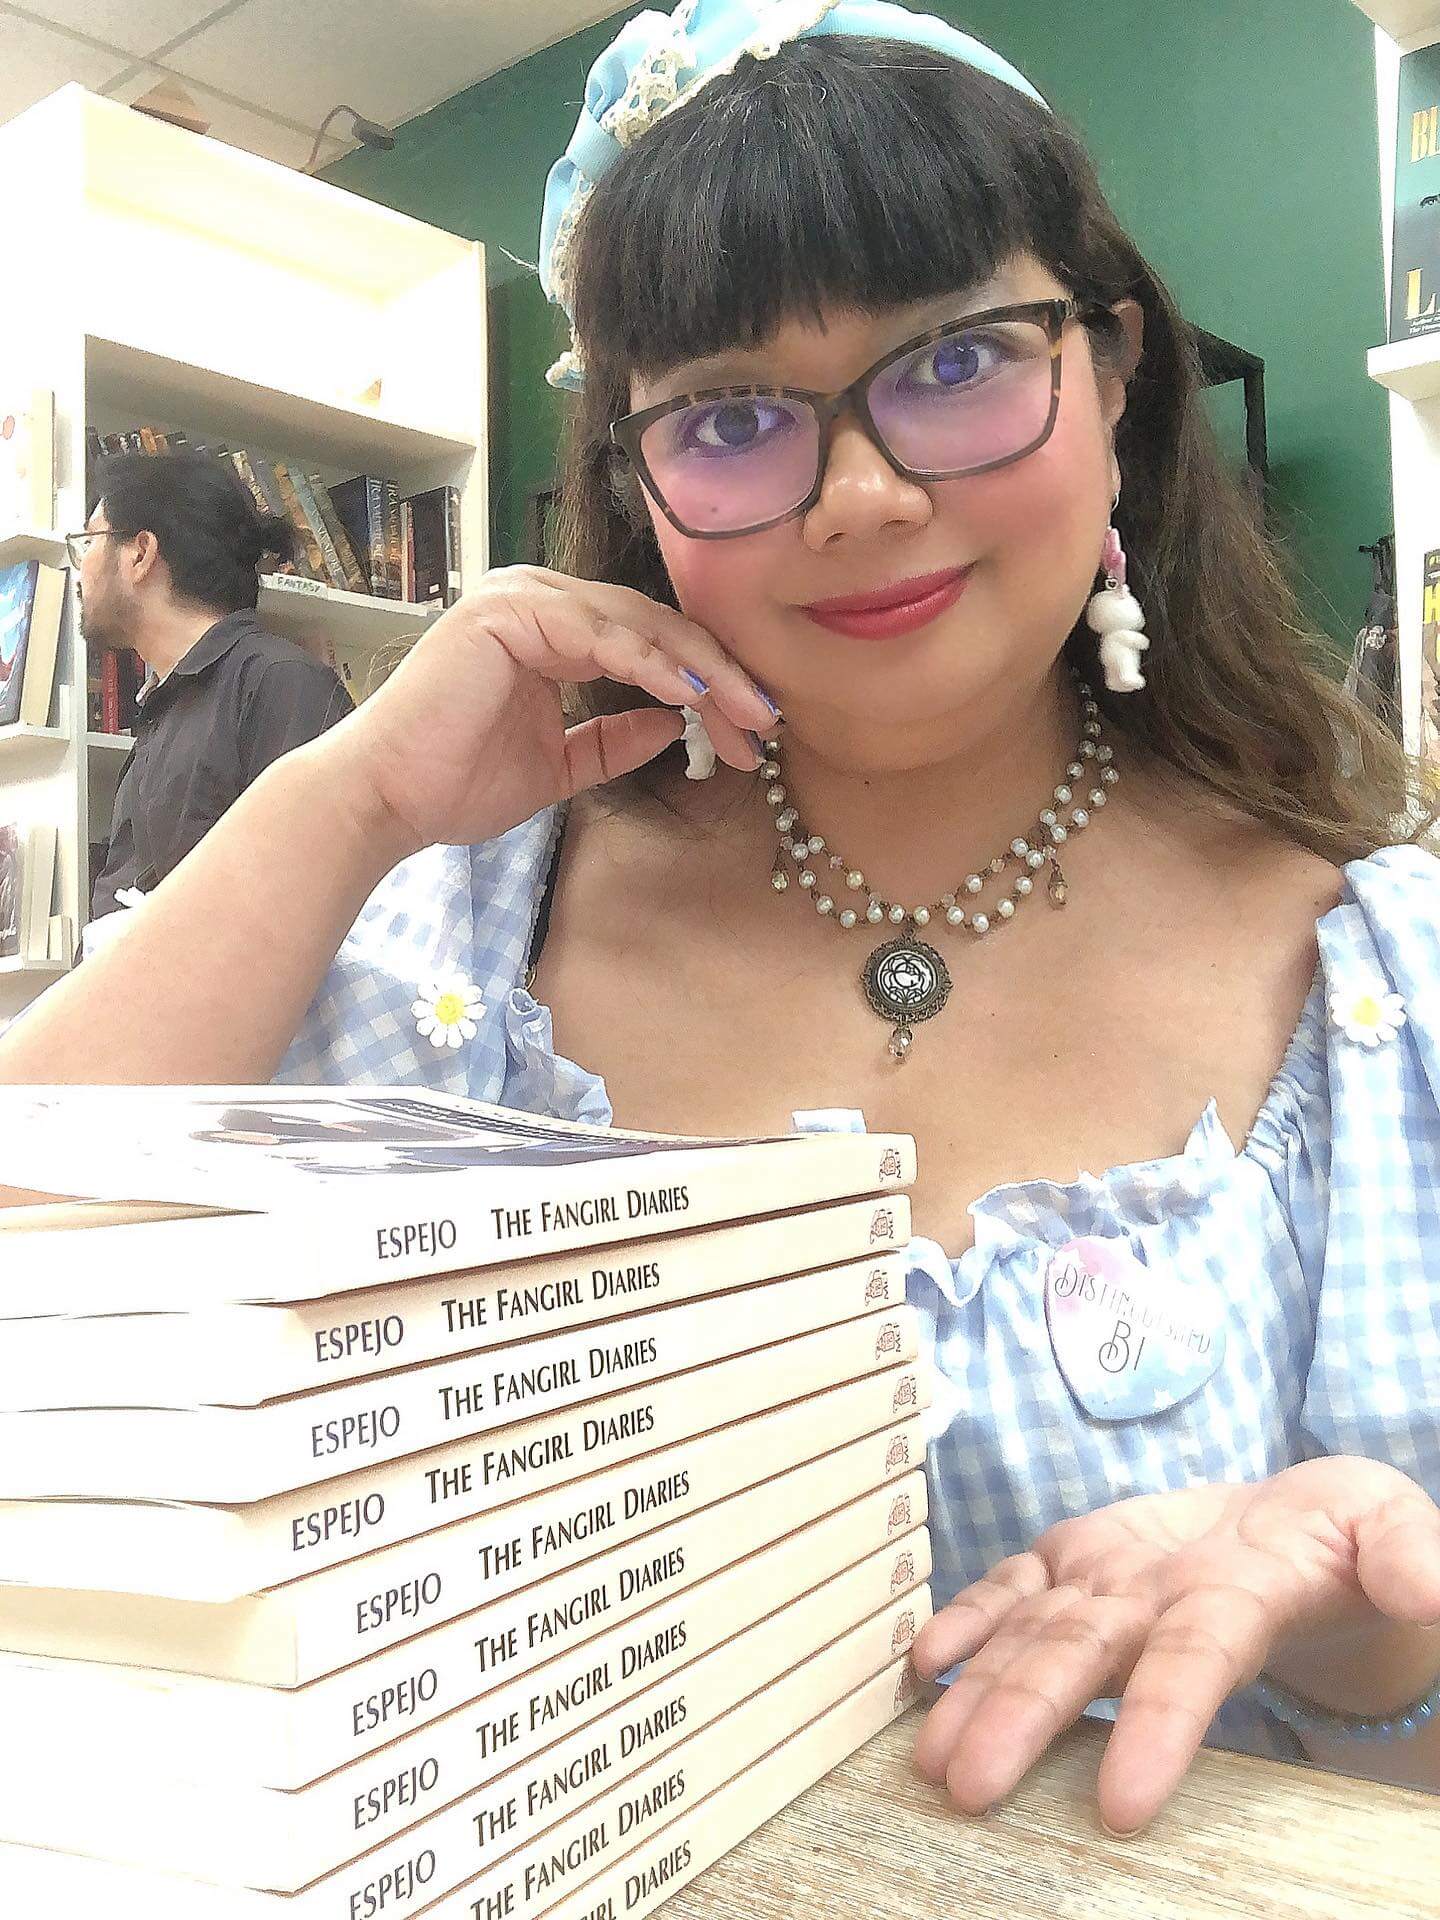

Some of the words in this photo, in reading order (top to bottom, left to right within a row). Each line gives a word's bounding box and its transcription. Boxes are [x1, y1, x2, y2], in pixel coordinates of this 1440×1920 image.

[376, 1219, 457, 1260] ESPEJO
[491, 1207, 533, 1240] THE
[541, 1196, 621, 1233] FANGIRL
[626, 1185, 690, 1219] DIARIES
[441, 1297, 488, 1333] THE
[496, 1278, 584, 1321] FANGIRL
[592, 1262, 661, 1300] DIARIES
[315, 1315, 405, 1363] ESPEJO
[438, 1383, 485, 1421] THE
[493, 1358, 581, 1407] FANGIRL
[588, 1337, 658, 1379] DIARIES
[311, 1406, 401, 1458] ESPEJO
[425, 1463, 473, 1504] THE
[483, 1432, 574, 1486] FANGIRL
[583, 1404, 655, 1452] DIARIES
[292, 1493, 386, 1552] ESPEJO
[478, 1537, 522, 1581] THE
[532, 1501, 616, 1560] FANGIRL
[624, 1470, 690, 1520] DIARIES
[356, 1572, 442, 1634] ESPEJO
[474, 1627, 518, 1673] THE
[527, 1584, 612, 1649] FANGIRL
[619, 1546, 686, 1602] DIARIES
[352, 1668, 438, 1737] ESPEJO
[475, 1711, 520, 1759] THE
[529, 1662, 613, 1732] FANGIRL
[621, 1620, 688, 1680] DIARIES
[354, 1757, 440, 1830] ESPEJO
[472, 1797, 517, 1848] THE
[527, 1743, 612, 1817] FANGIRL
[620, 1695, 687, 1759] DIARIES
[525, 1822, 610, 1902] FANGIRL
[618, 1768, 685, 1837] DIARIES
[350, 1849, 437, 1920] ESPEJO
[625, 1839, 692, 1911] DIARIES
